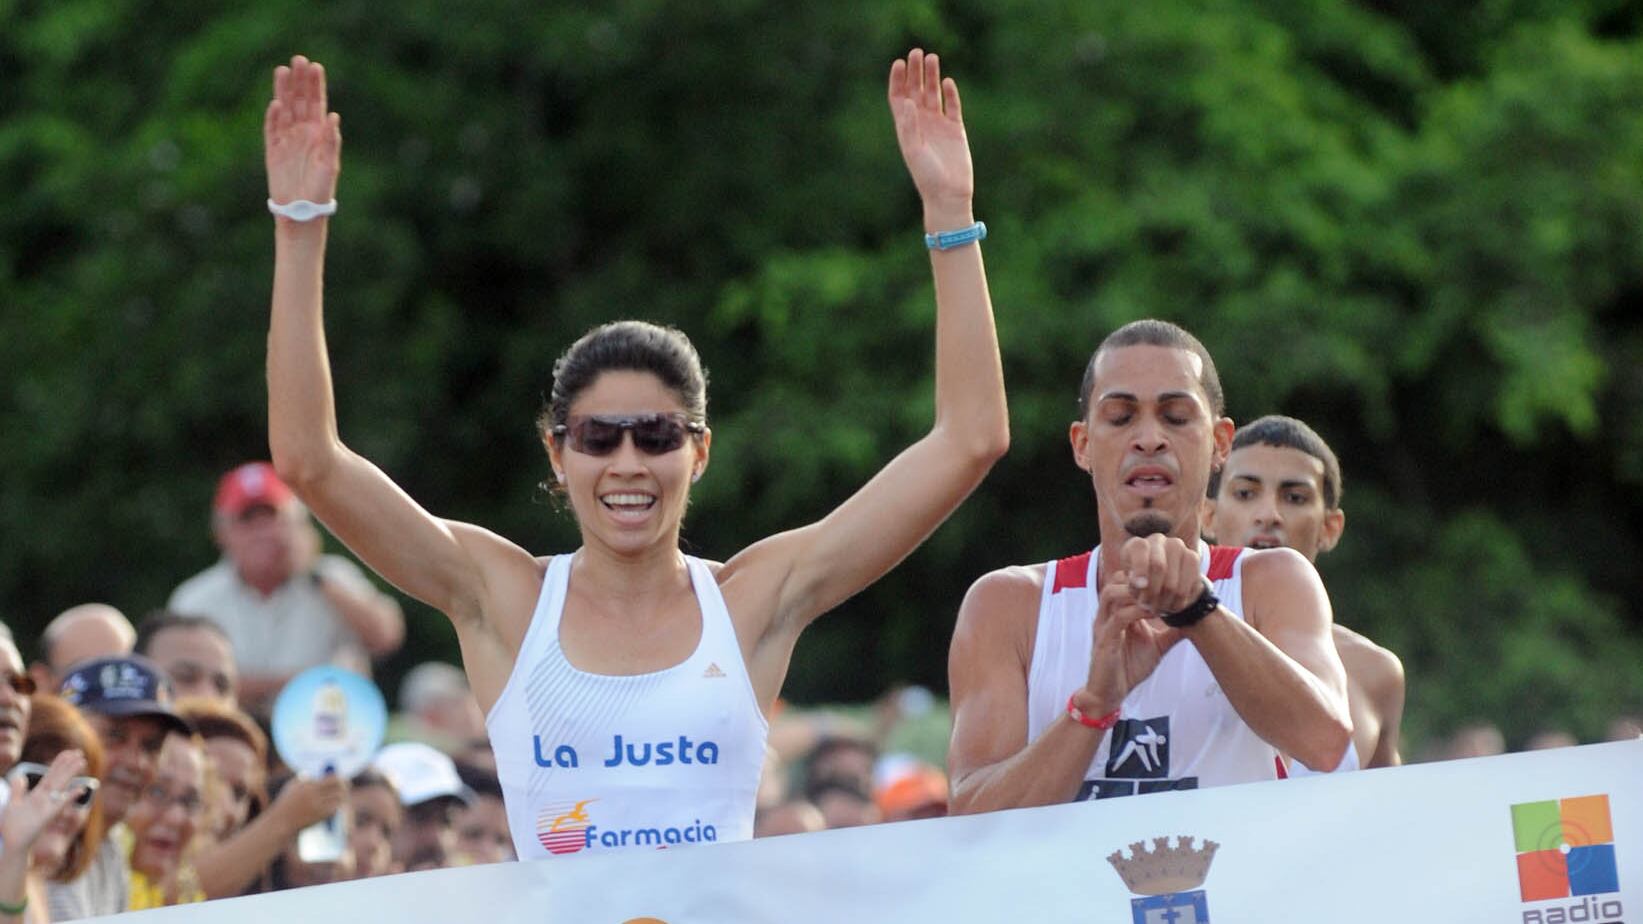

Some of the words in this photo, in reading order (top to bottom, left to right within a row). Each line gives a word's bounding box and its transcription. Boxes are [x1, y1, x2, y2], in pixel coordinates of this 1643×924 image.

[533, 735, 578, 768] La
[604, 735, 719, 768] Justa
[585, 819, 717, 848] Farmacia
[1522, 896, 1623, 924] Radio
